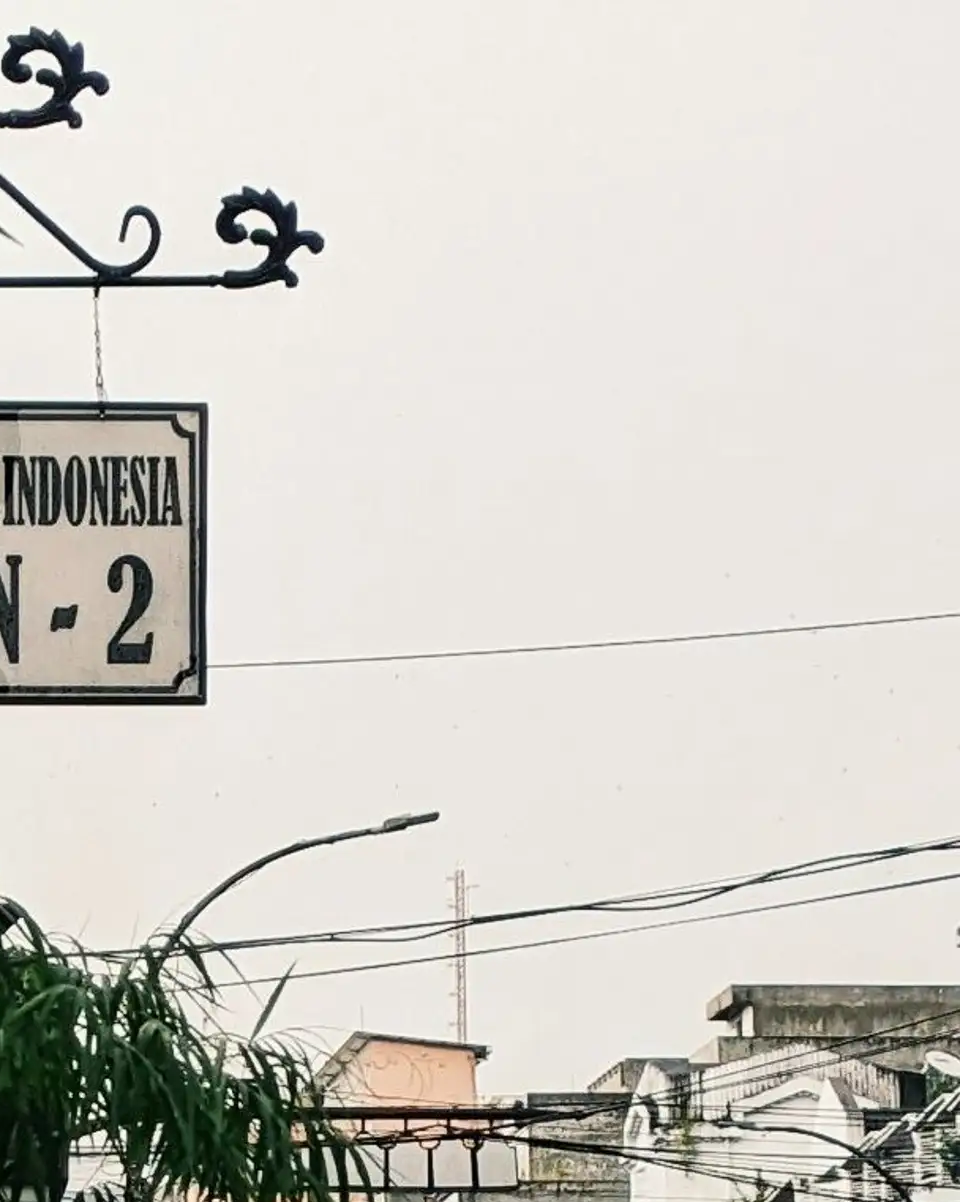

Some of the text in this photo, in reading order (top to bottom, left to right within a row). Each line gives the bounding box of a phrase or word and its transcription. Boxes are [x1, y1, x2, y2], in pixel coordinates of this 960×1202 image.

[2, 455, 183, 527] INDONESIA
[50, 603, 79, 633] -
[106, 554, 154, 664] 2
